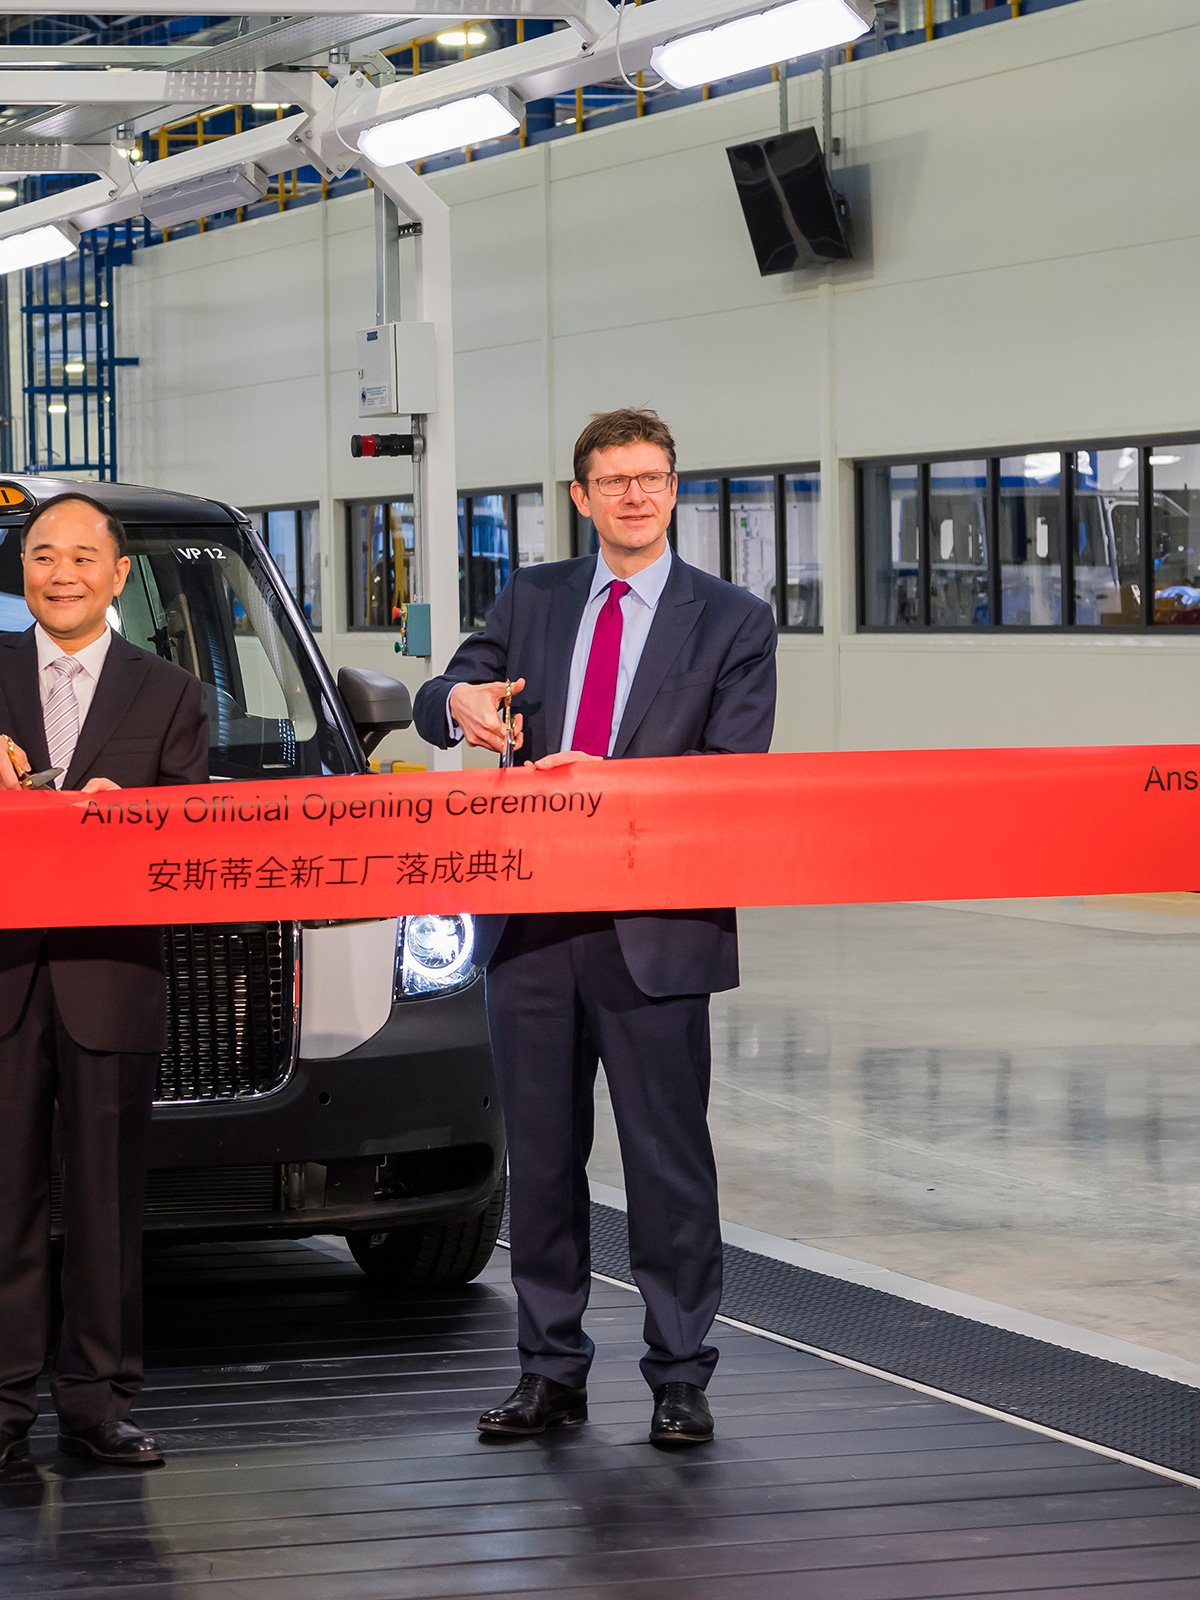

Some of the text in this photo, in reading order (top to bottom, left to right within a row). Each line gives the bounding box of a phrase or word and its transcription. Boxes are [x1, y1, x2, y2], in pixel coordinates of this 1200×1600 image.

[177, 547, 227, 560] VP 12
[1143, 765, 1200, 792] Ans
[81, 790, 603, 830] Ansty Official Opening Ceremony
[147, 849, 533, 892] 安斯蒂全新工厂落成典礼
